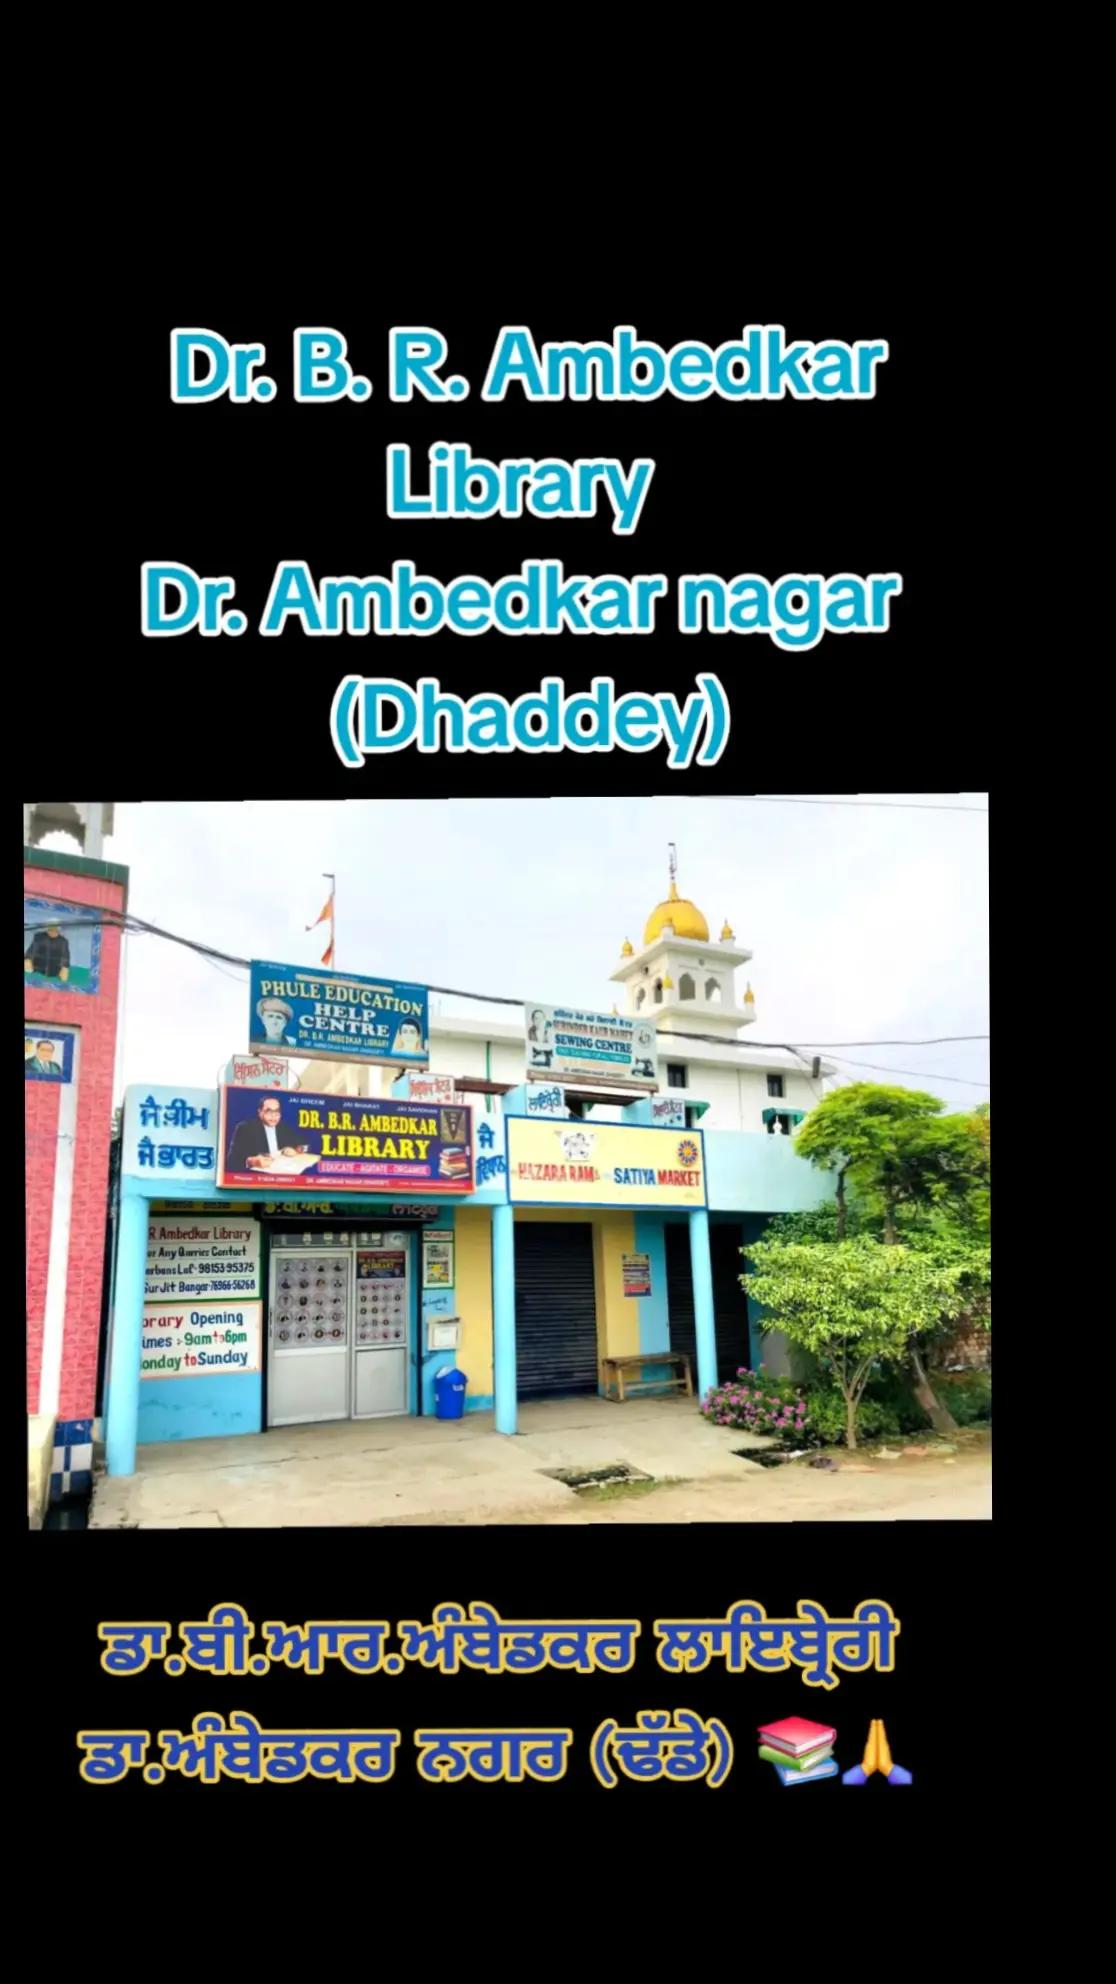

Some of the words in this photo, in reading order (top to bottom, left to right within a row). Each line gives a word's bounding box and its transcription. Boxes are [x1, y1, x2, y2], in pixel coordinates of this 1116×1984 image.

[260, 980, 321, 999] PHULE
[325, 984, 423, 1016] EDUCATION
[314, 1002, 376, 1022] HELP
[299, 1015, 390, 1038] CENTRE
[555, 1034, 593, 1048] SEWING
[595, 1040, 632, 1053] CENTRE
[139, 1095, 161, 1128] ਜੈ
[298, 1109, 324, 1129] DR.
[327, 1111, 356, 1131] B.R.
[359, 1114, 438, 1136] AMBEDKAR
[138, 1136, 156, 1168] ਜੈ
[321, 1134, 431, 1160] LIBRARY
[614, 1167, 656, 1185] SATIYA
[658, 1168, 700, 1187] MARKET
[159, 1227, 211, 1240] Ambedkar
[213, 1227, 251, 1241] Library
[158, 1246, 176, 1260] Any
[211, 1245, 247, 1256] Contact
[145, 1265, 176, 1275] arbans
[190, 1311, 243, 1327] Opening
[142, 1336, 172, 1349] imes
[224, 1329, 247, 1345] 6pm
[142, 1354, 181, 1371] onday
[184, 1352, 197, 1367] to
[198, 1349, 248, 1366] Sunday
